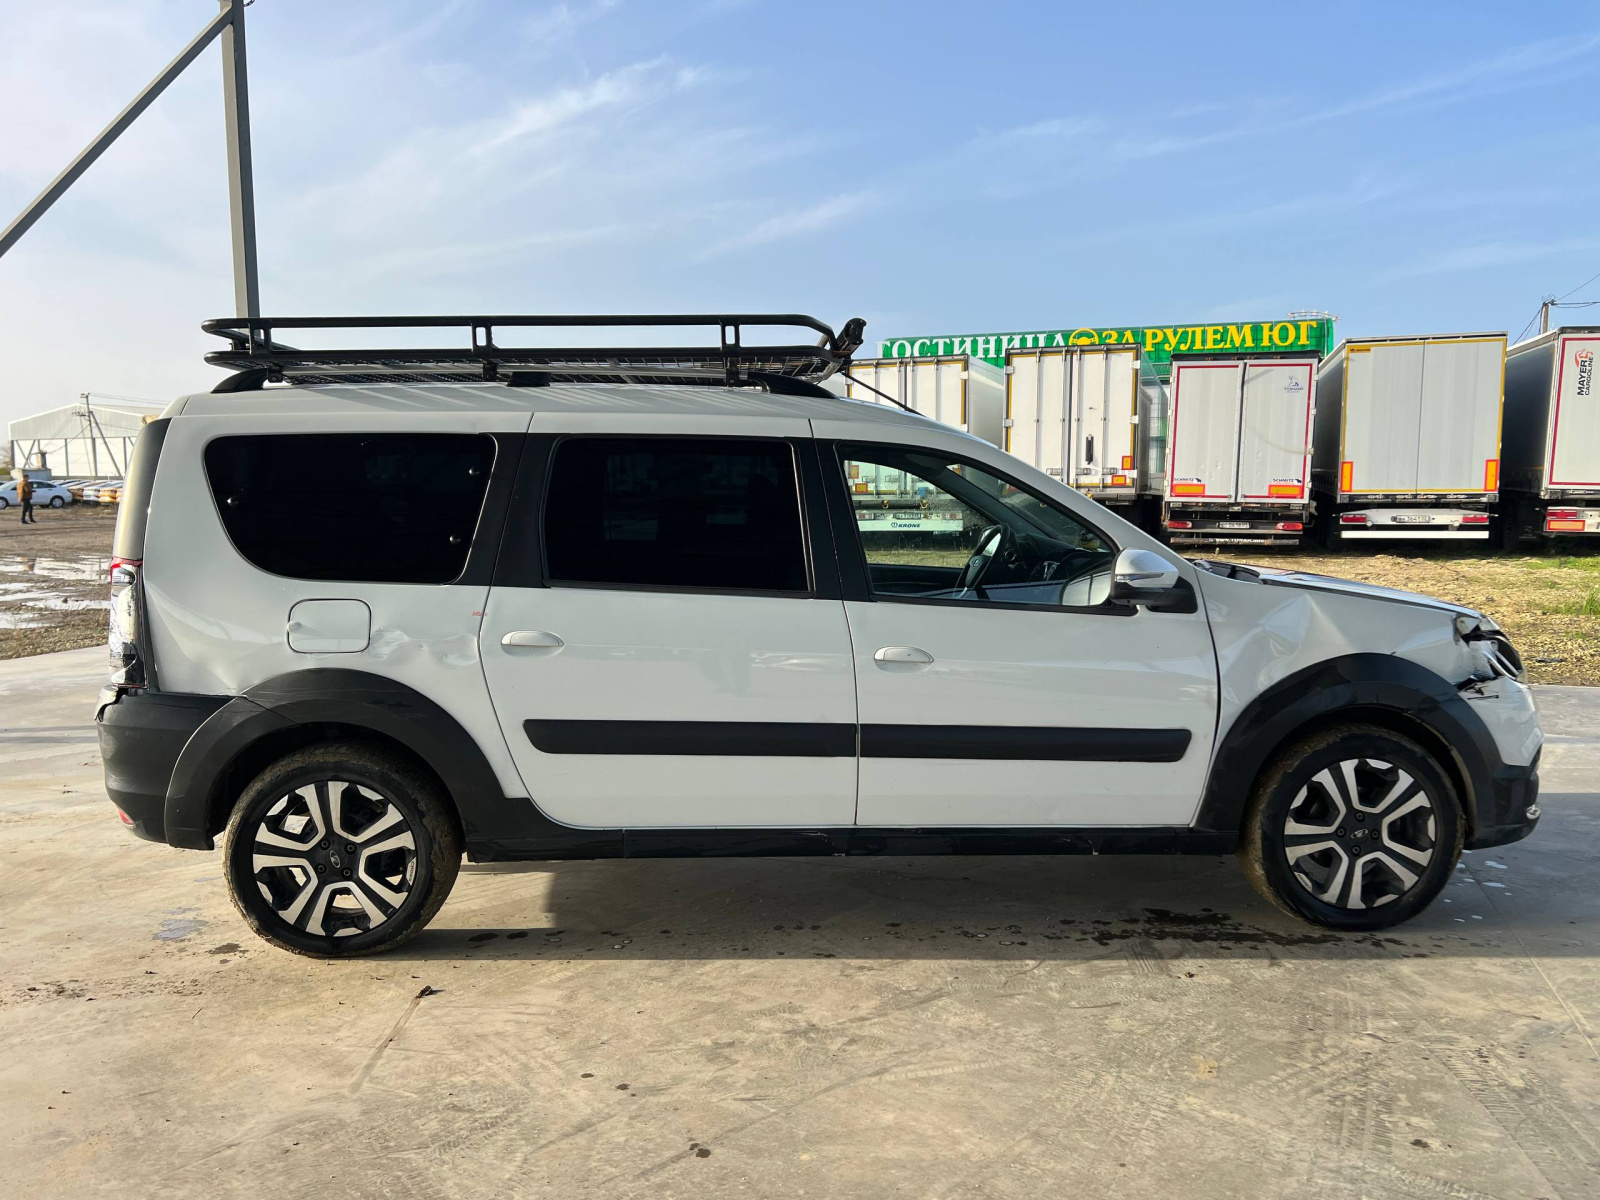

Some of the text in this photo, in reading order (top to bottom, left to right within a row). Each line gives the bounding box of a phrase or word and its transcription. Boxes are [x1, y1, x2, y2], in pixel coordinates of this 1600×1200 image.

[876, 333, 1065, 358] ГОСТИНИЦА
[1144, 325, 1254, 352] РУЛЕМ
[1261, 321, 1317, 346] ЮГ
[1577, 359, 1588, 396] MAYER
[1585, 357, 1594, 396] CARGOLINE
